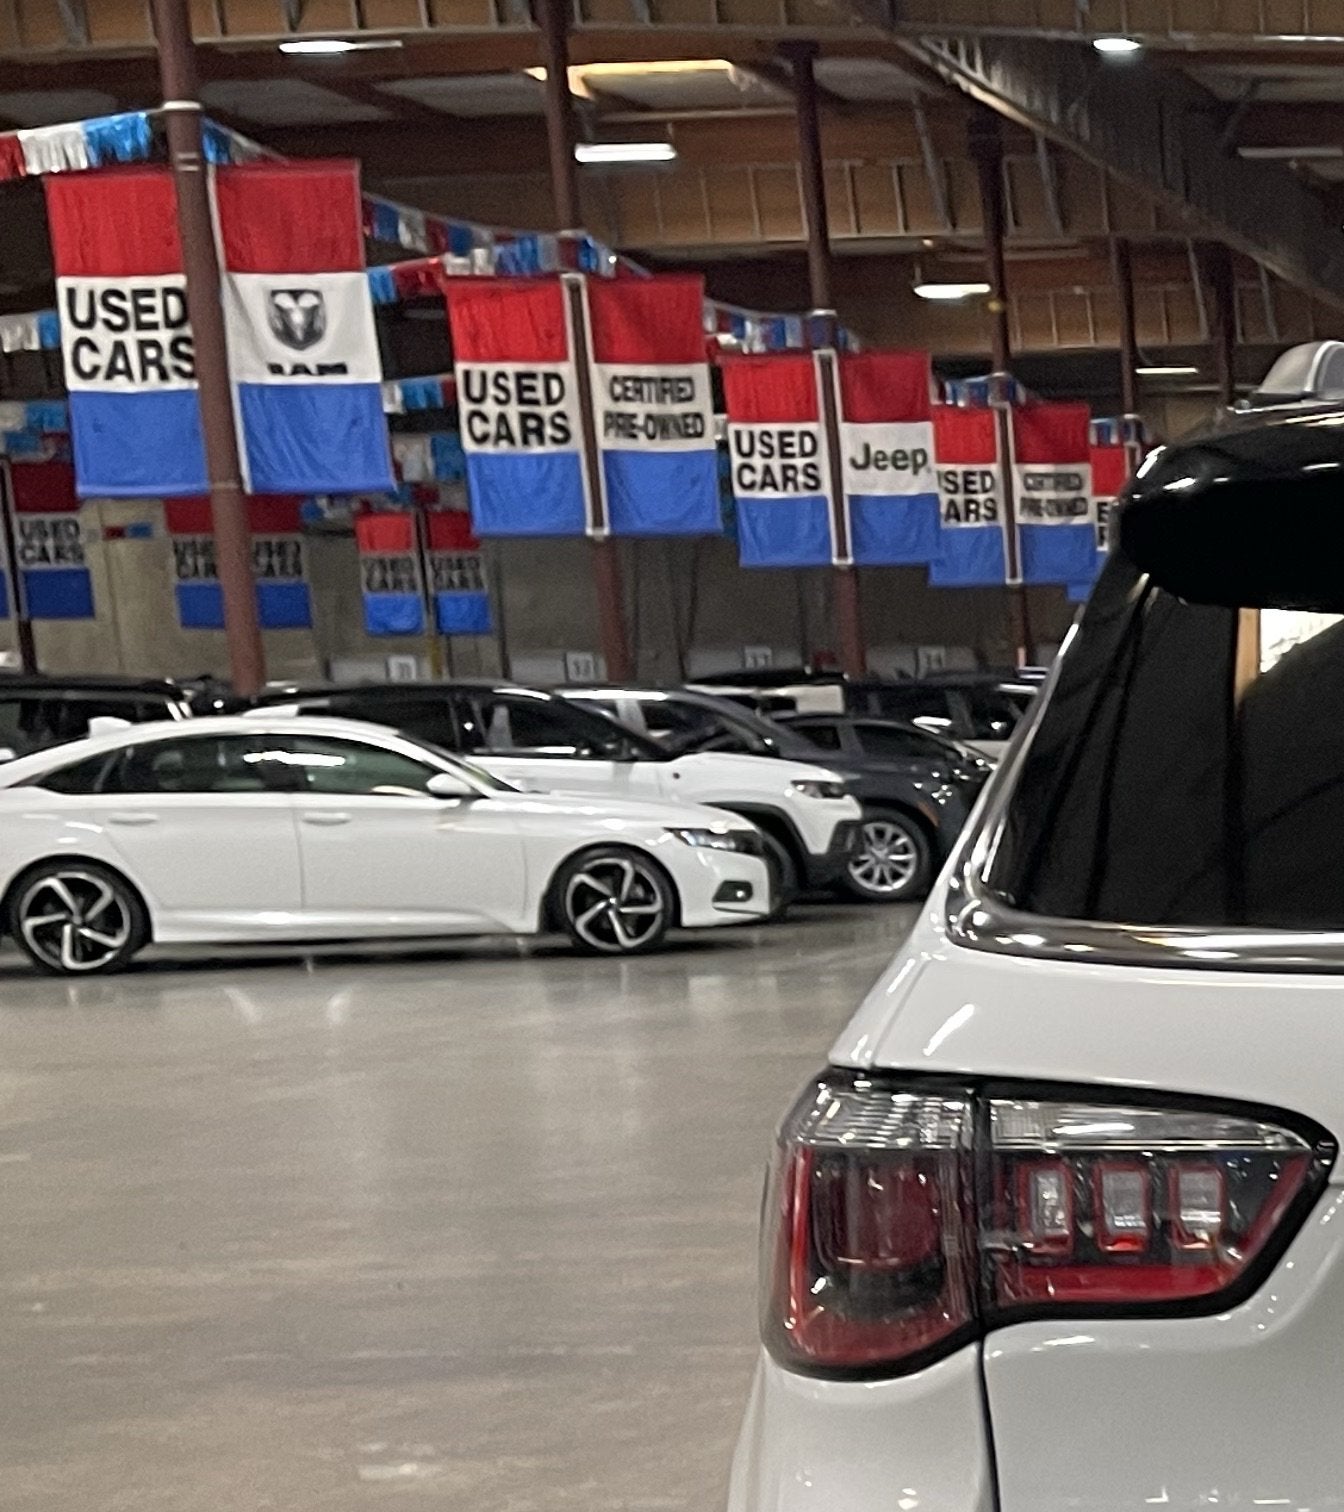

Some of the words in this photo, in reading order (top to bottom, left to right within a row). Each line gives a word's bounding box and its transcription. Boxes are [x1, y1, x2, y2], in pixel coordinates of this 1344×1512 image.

[65, 286, 188, 333] USED
[71, 336, 196, 382] CARS
[462, 369, 566, 407] USED
[609, 375, 696, 404] CERTIFIED
[466, 409, 572, 447] CARS
[603, 410, 705, 440] PRE-OWNED
[734, 429, 818, 459] USED
[850, 442, 928, 476] Jeep
[737, 462, 822, 492] CARS
[937, 469, 996, 495] SED
[943, 498, 998, 523] ARS
